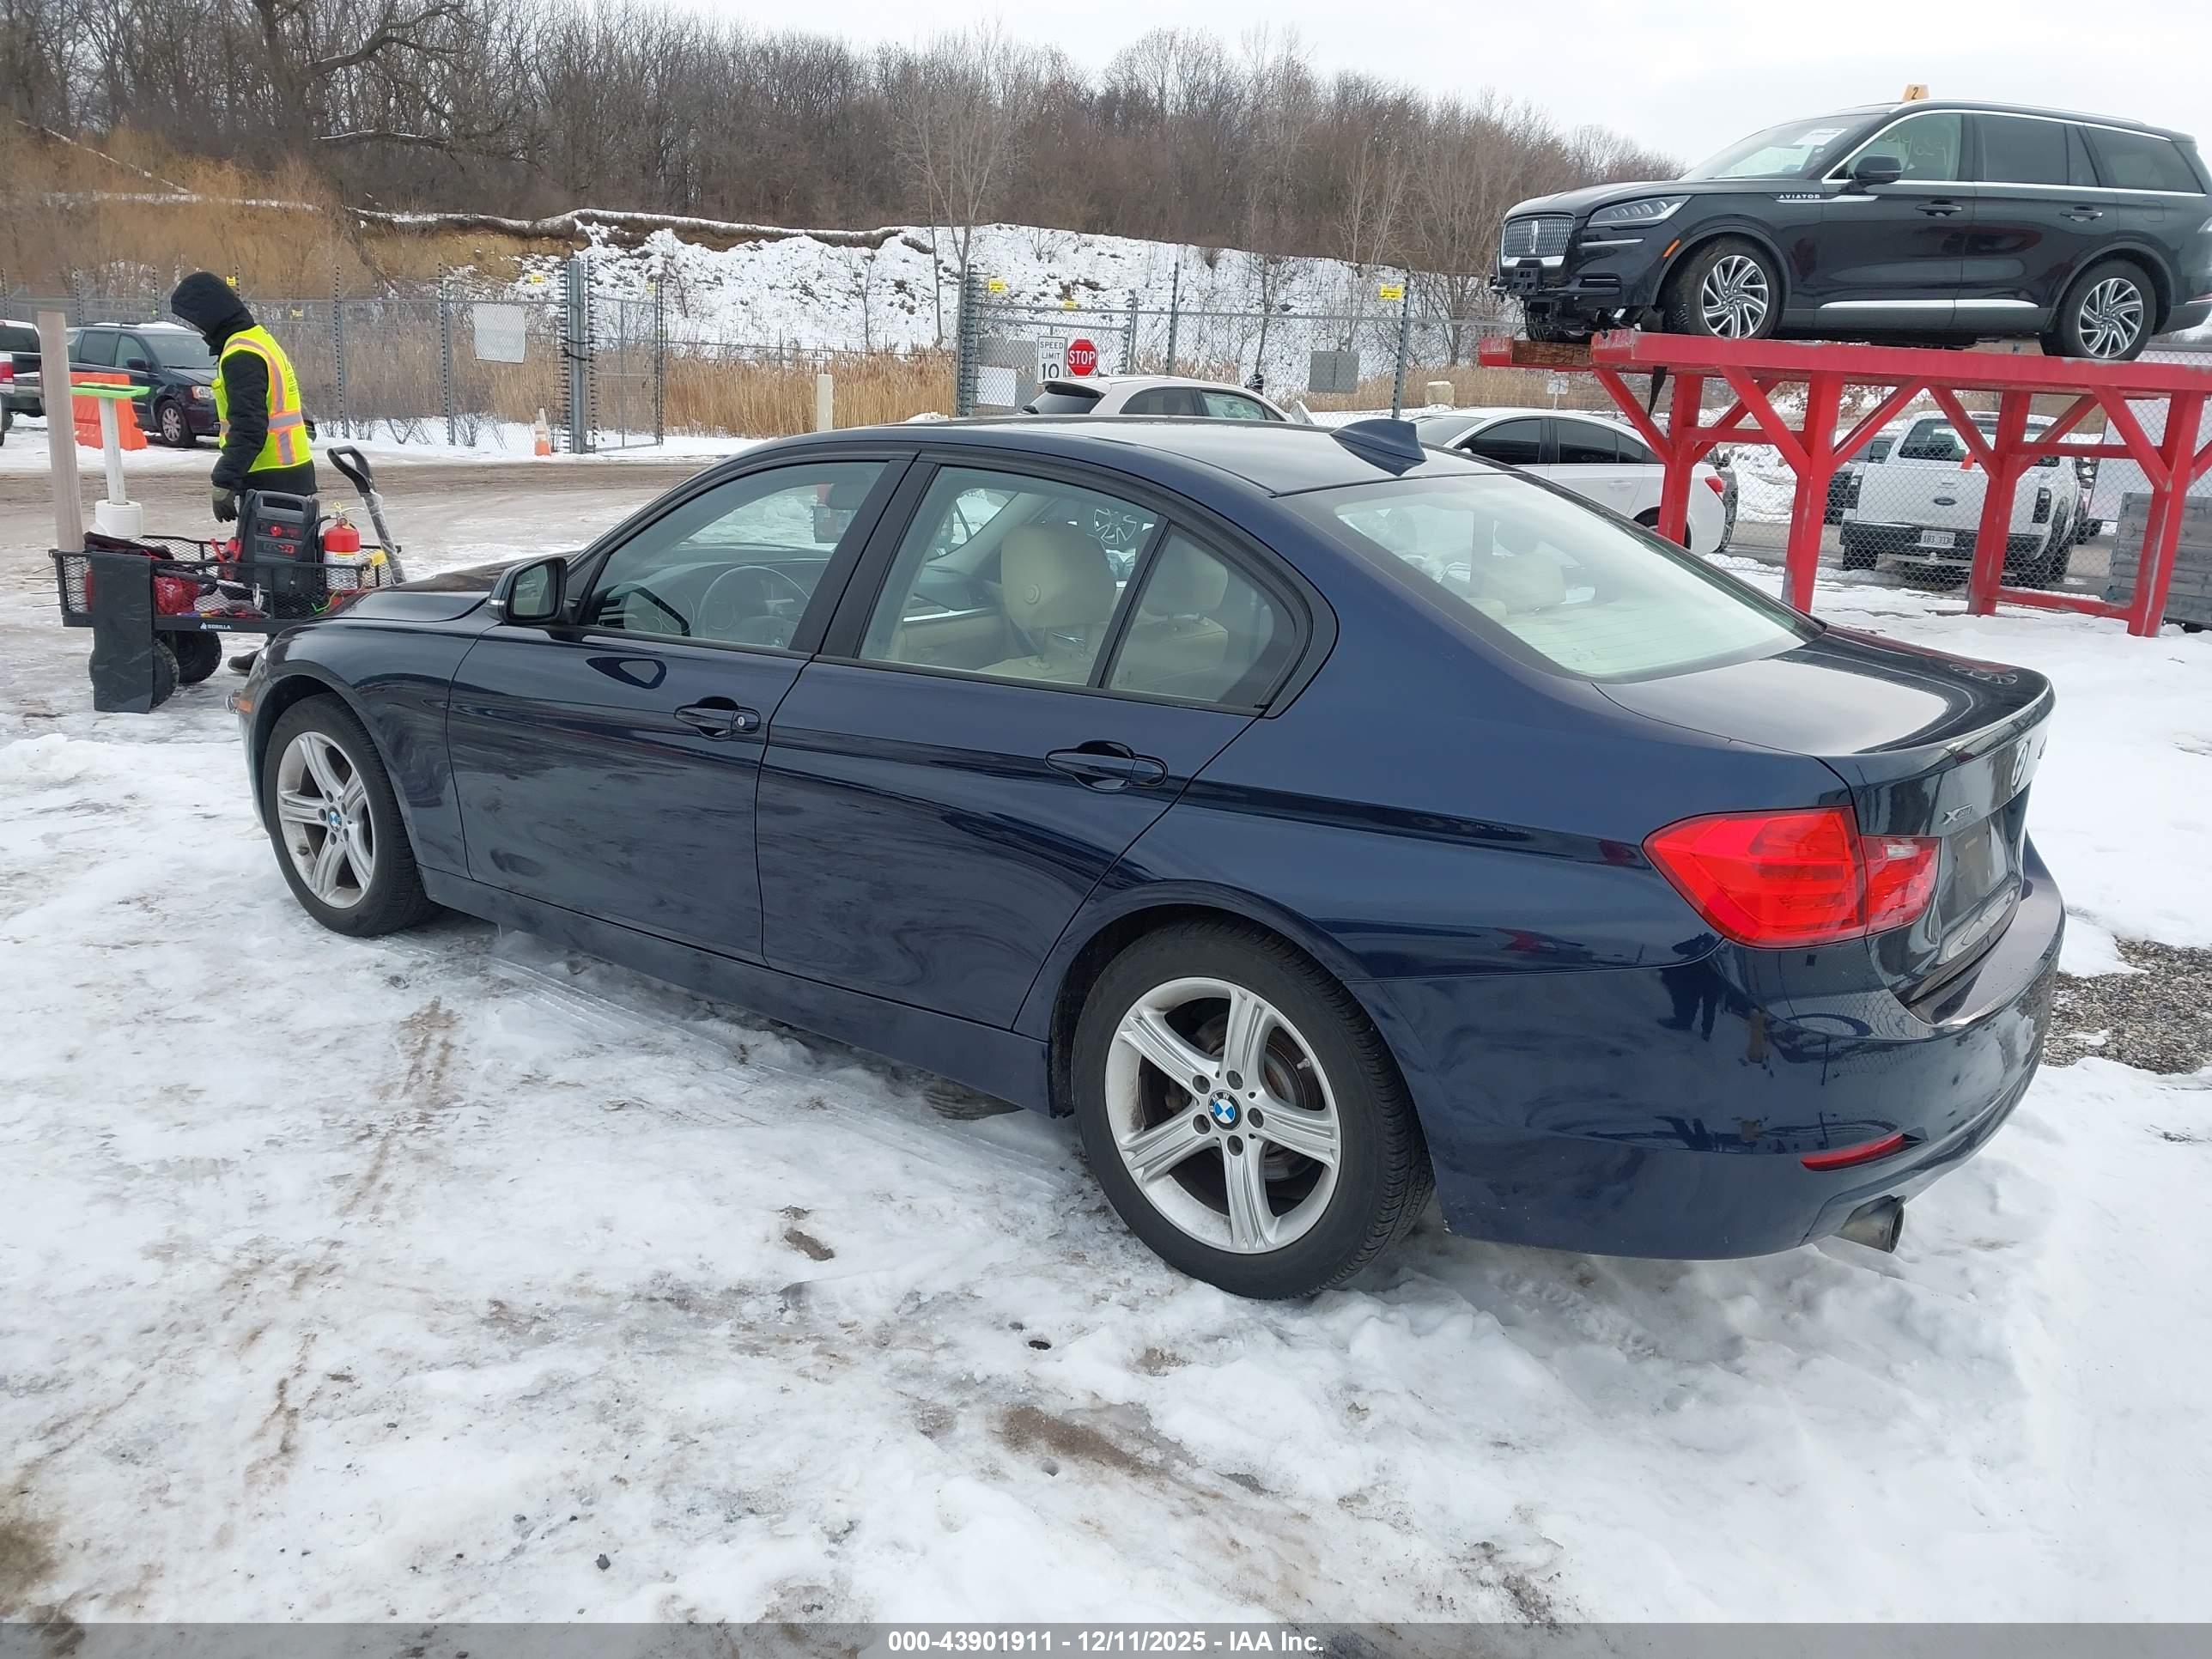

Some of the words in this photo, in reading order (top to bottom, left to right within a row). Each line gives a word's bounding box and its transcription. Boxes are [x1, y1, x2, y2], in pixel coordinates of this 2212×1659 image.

[1911, 87, 1919, 100] 2
[1068, 349, 1095, 365] STOP
[1042, 362, 1060, 380] 10
